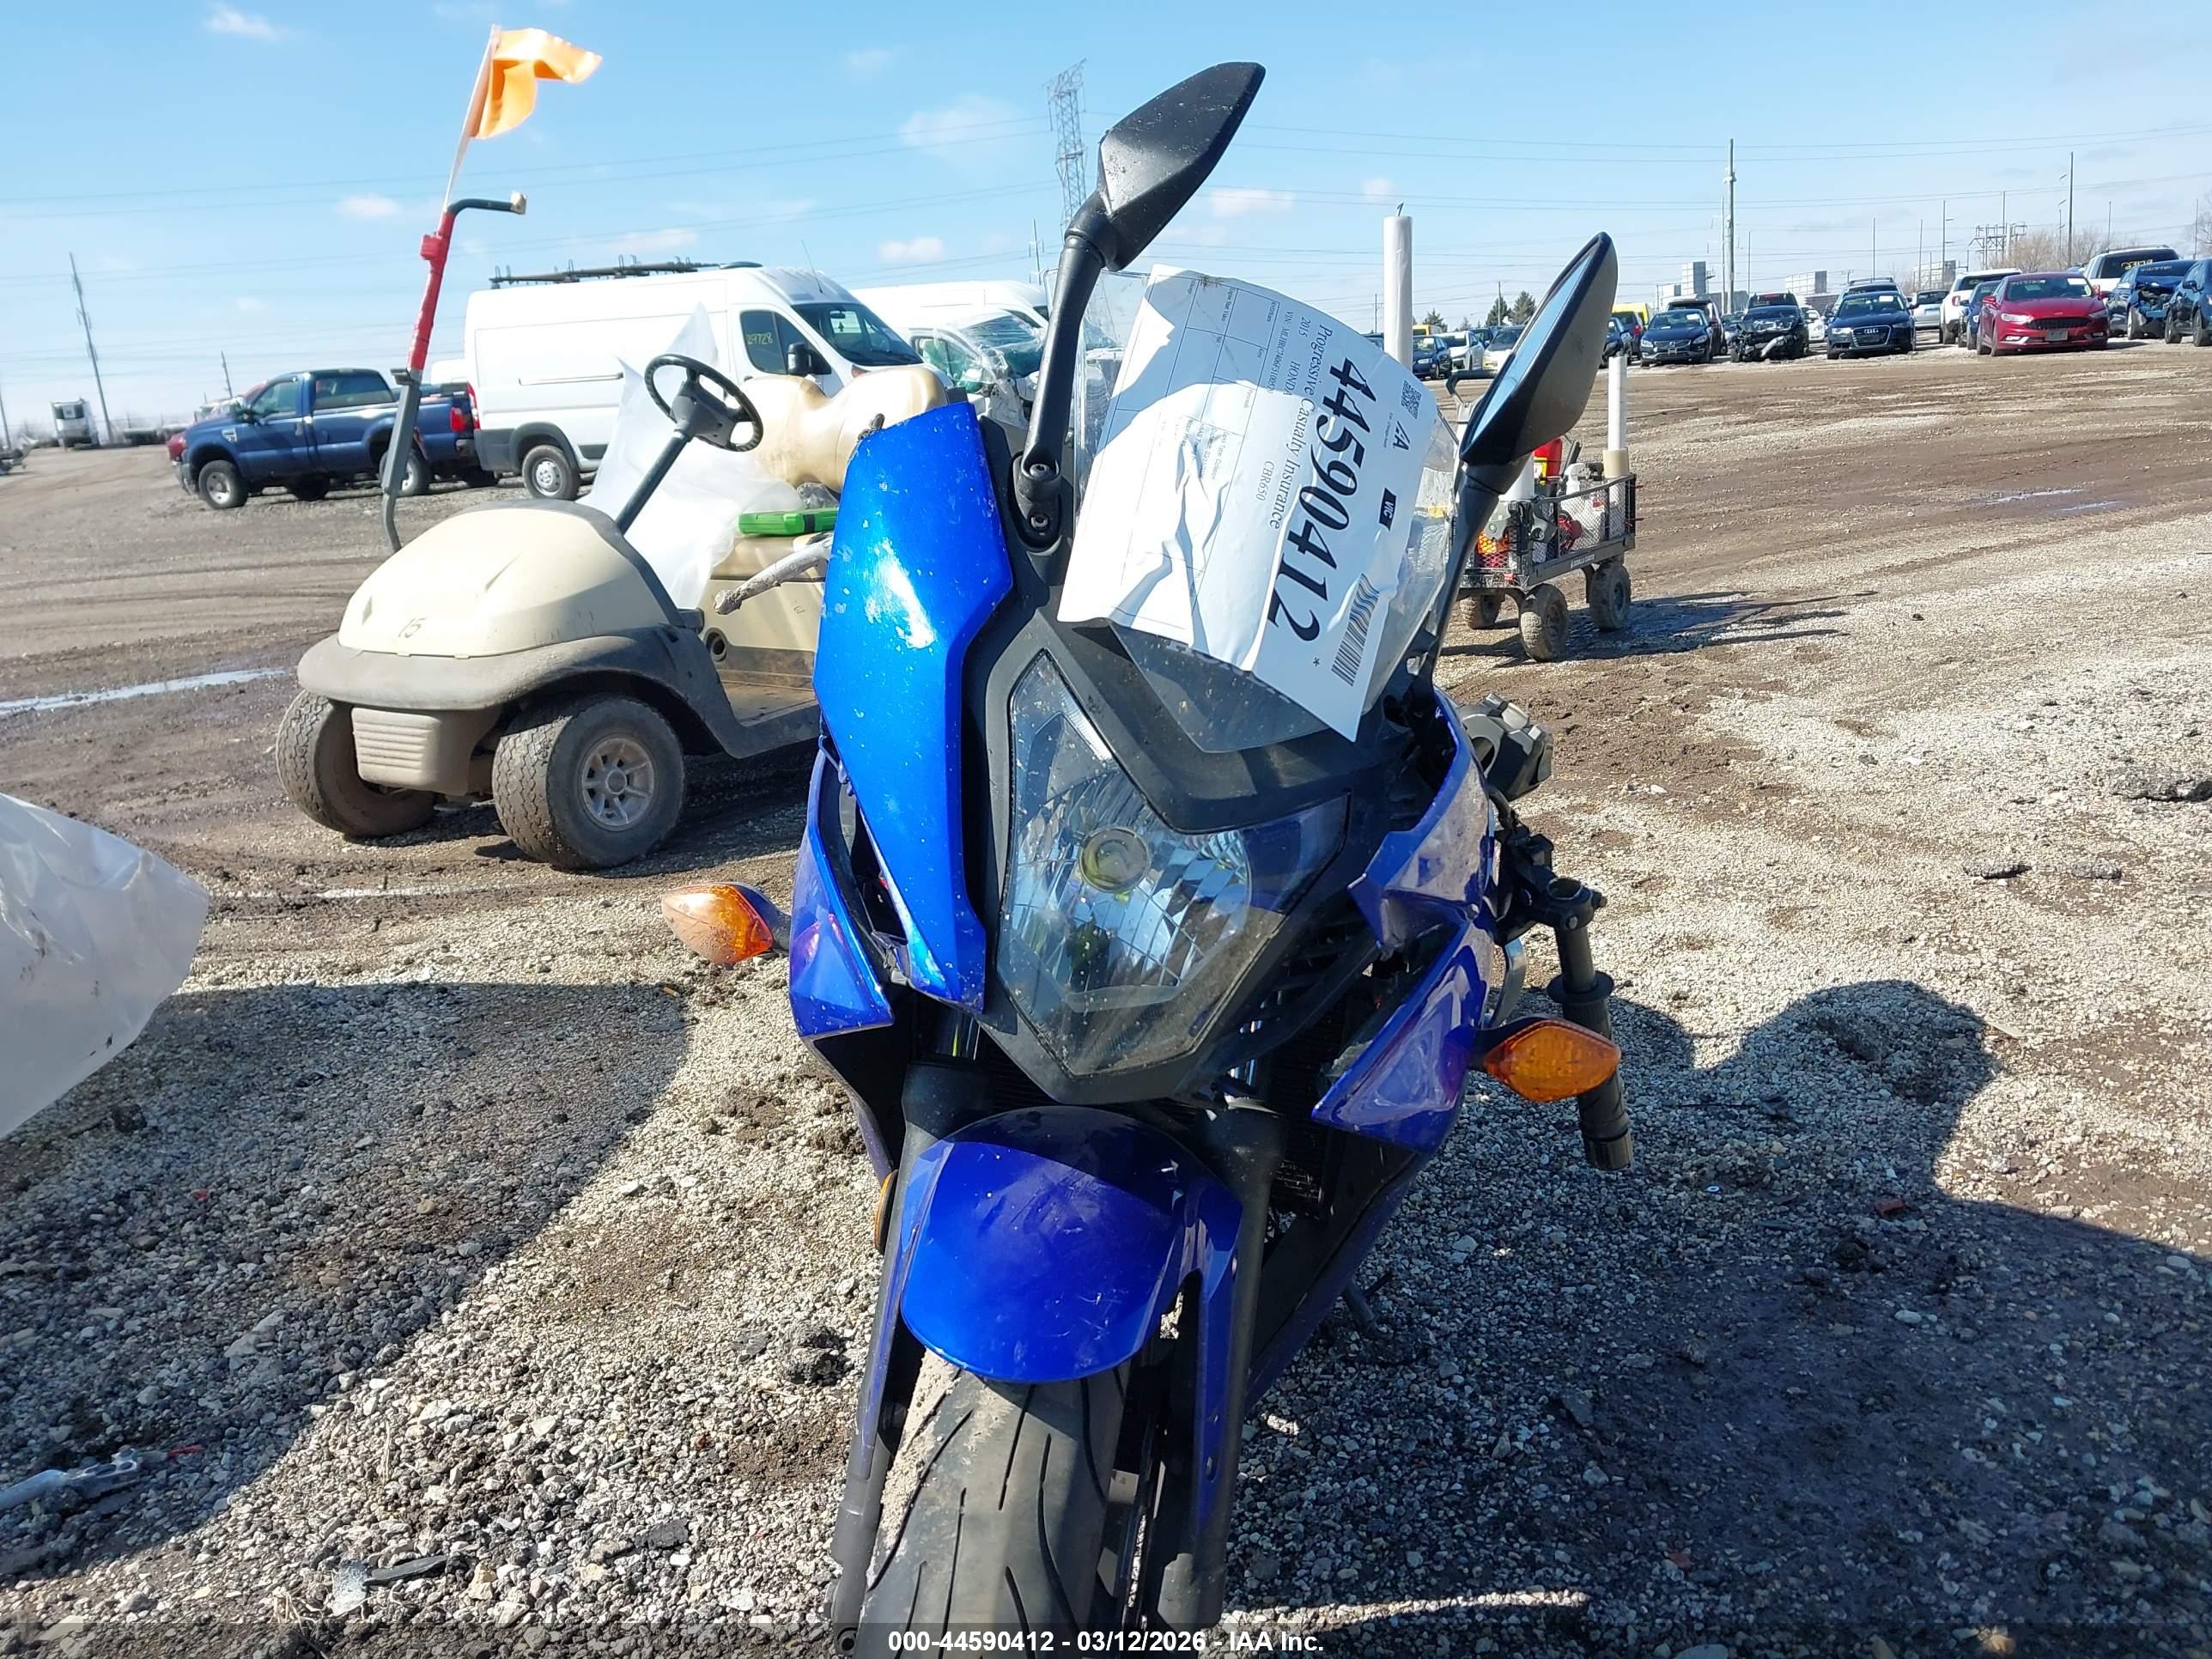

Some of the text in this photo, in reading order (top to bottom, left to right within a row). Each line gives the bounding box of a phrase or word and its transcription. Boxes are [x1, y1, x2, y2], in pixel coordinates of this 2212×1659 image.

[1255, 317, 1311, 501] 2015 HONDA CBR650
[1267, 357, 1376, 642] 44590412
[1270, 325, 1333, 530] Progressive Casualty Insurance
[1383, 501, 1395, 519] VIC
